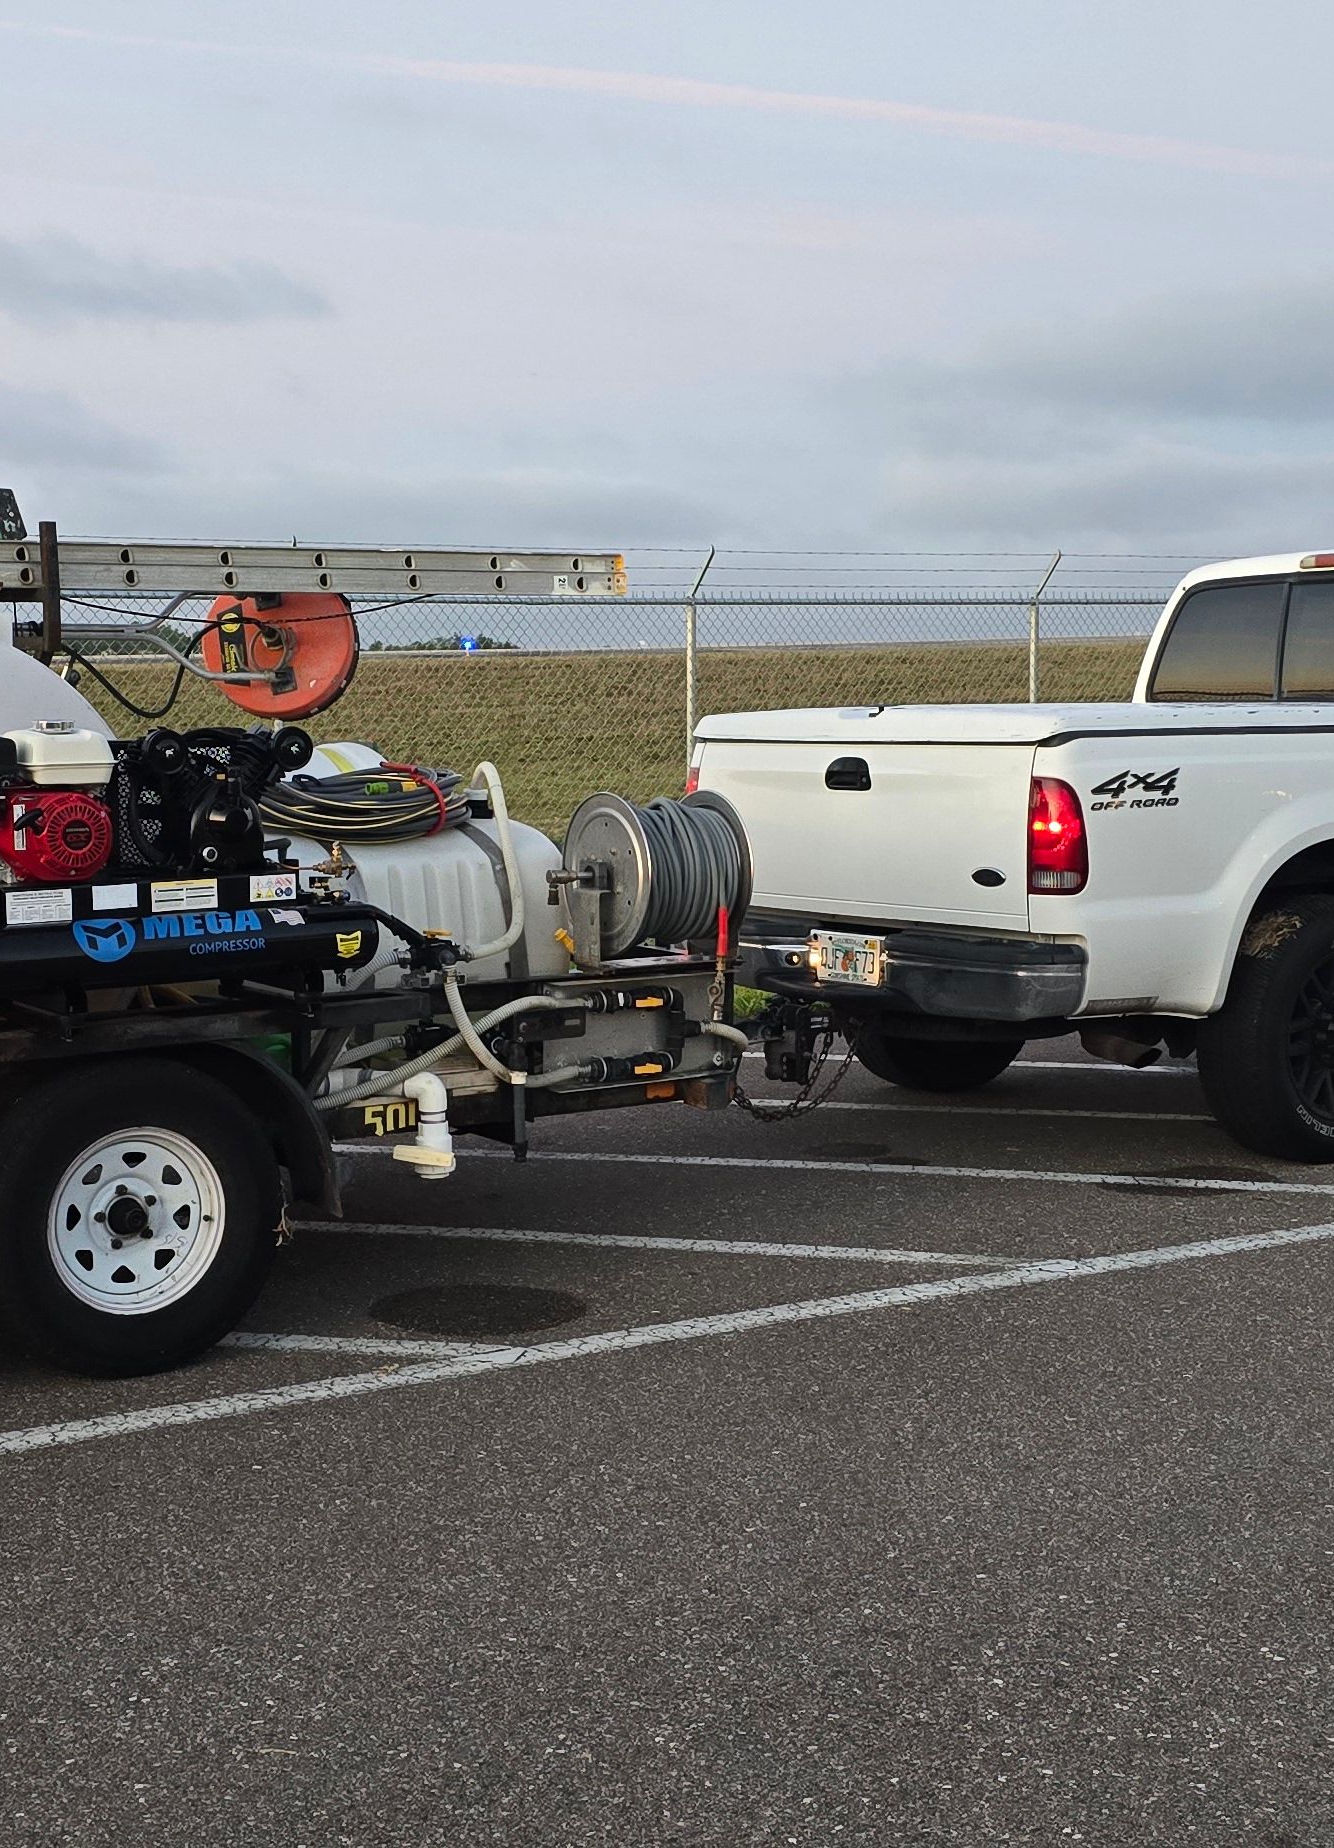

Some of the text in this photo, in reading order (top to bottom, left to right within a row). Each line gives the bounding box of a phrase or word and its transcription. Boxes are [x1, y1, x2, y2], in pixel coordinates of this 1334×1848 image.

[1091, 797, 1180, 811] OFF ROAD
[142, 910, 262, 940] MEGA
[189, 938, 266, 956] COMPRESSOR
